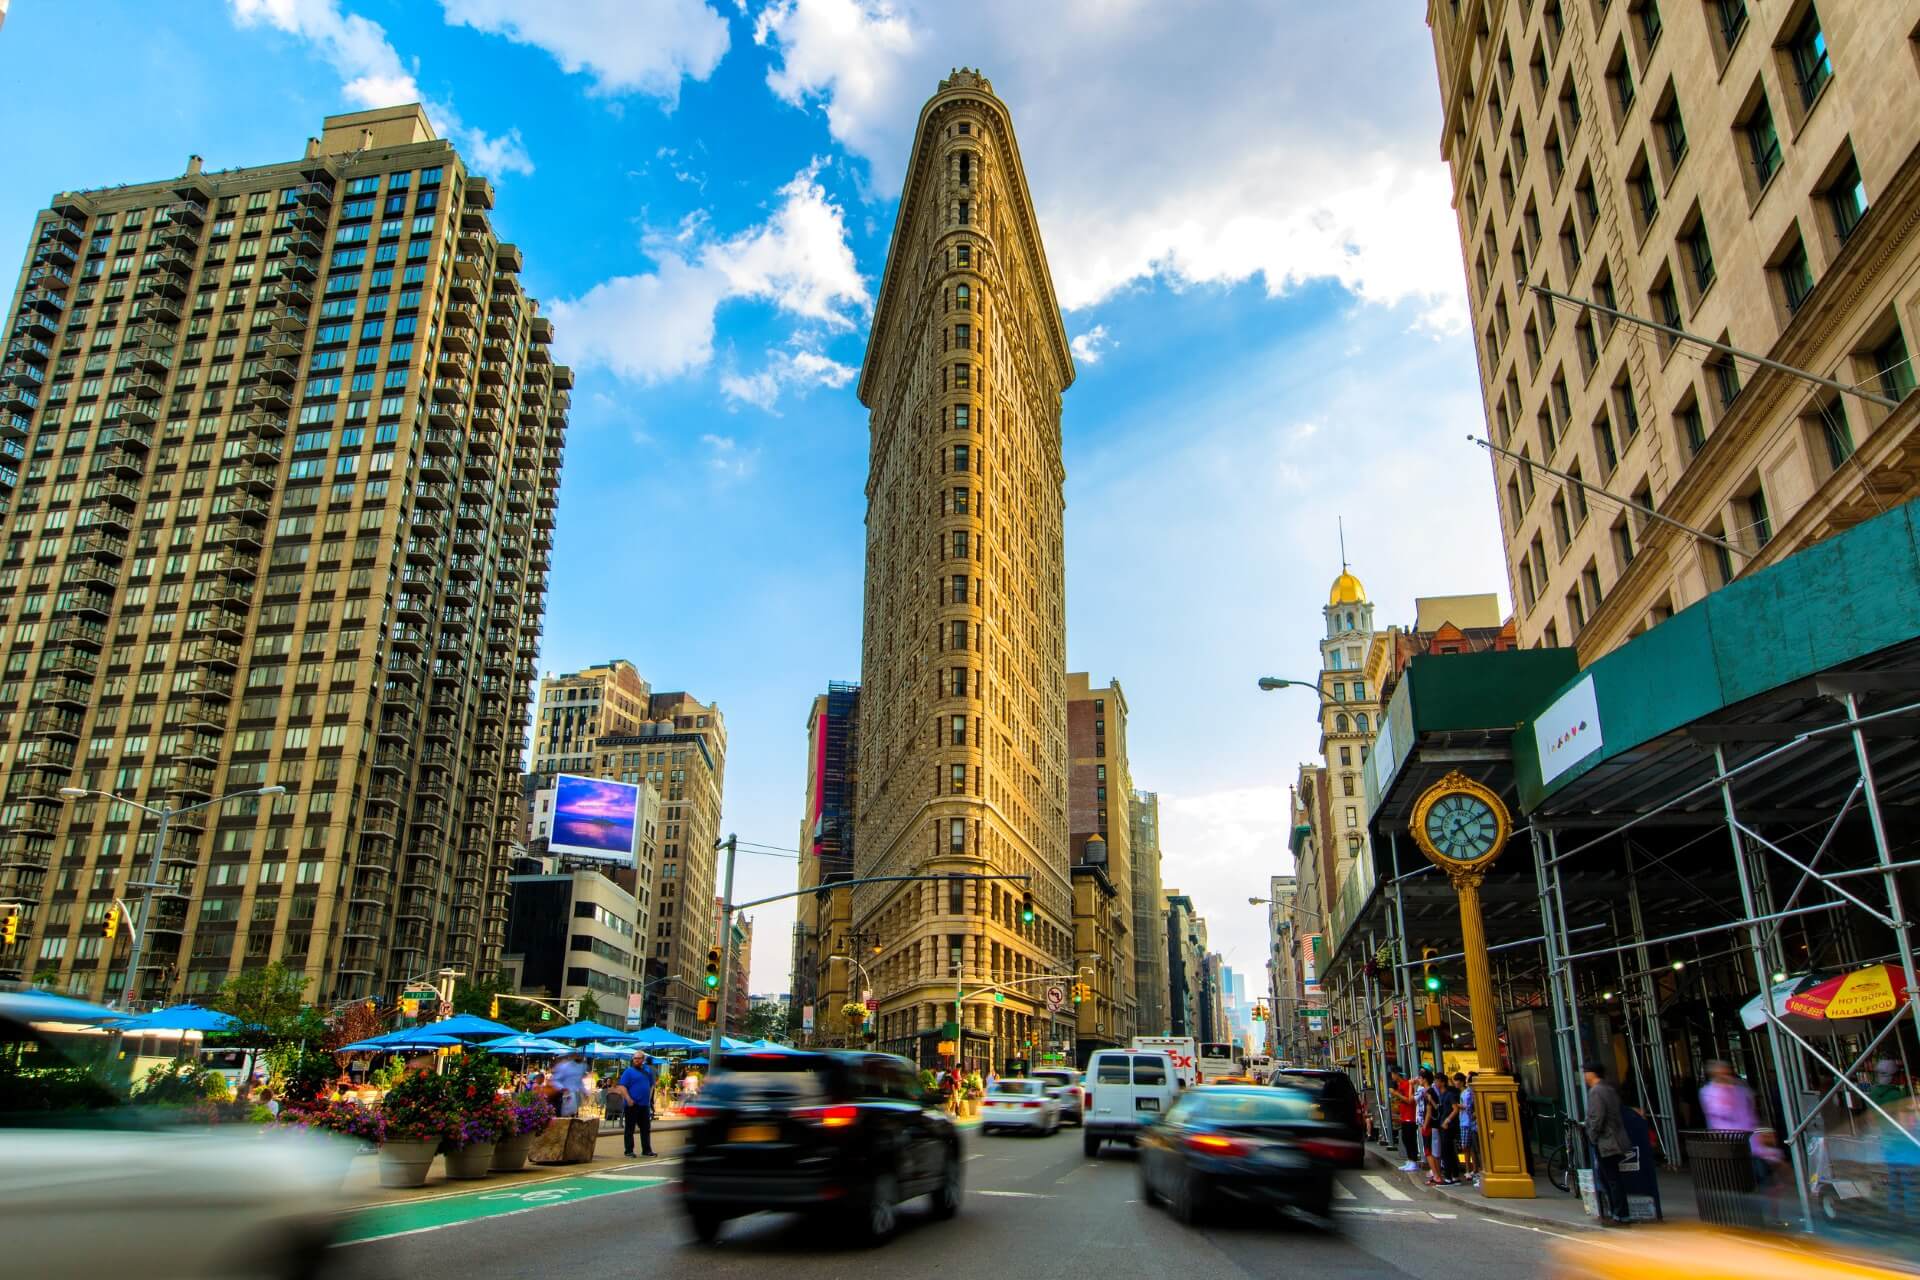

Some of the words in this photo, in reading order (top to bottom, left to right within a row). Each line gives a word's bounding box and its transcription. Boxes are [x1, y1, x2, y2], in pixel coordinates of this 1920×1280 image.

[1838, 997, 1858, 1005] HOT
[1831, 1007, 1864, 1016] HALAL
[1866, 1000, 1892, 1011] FOOD
